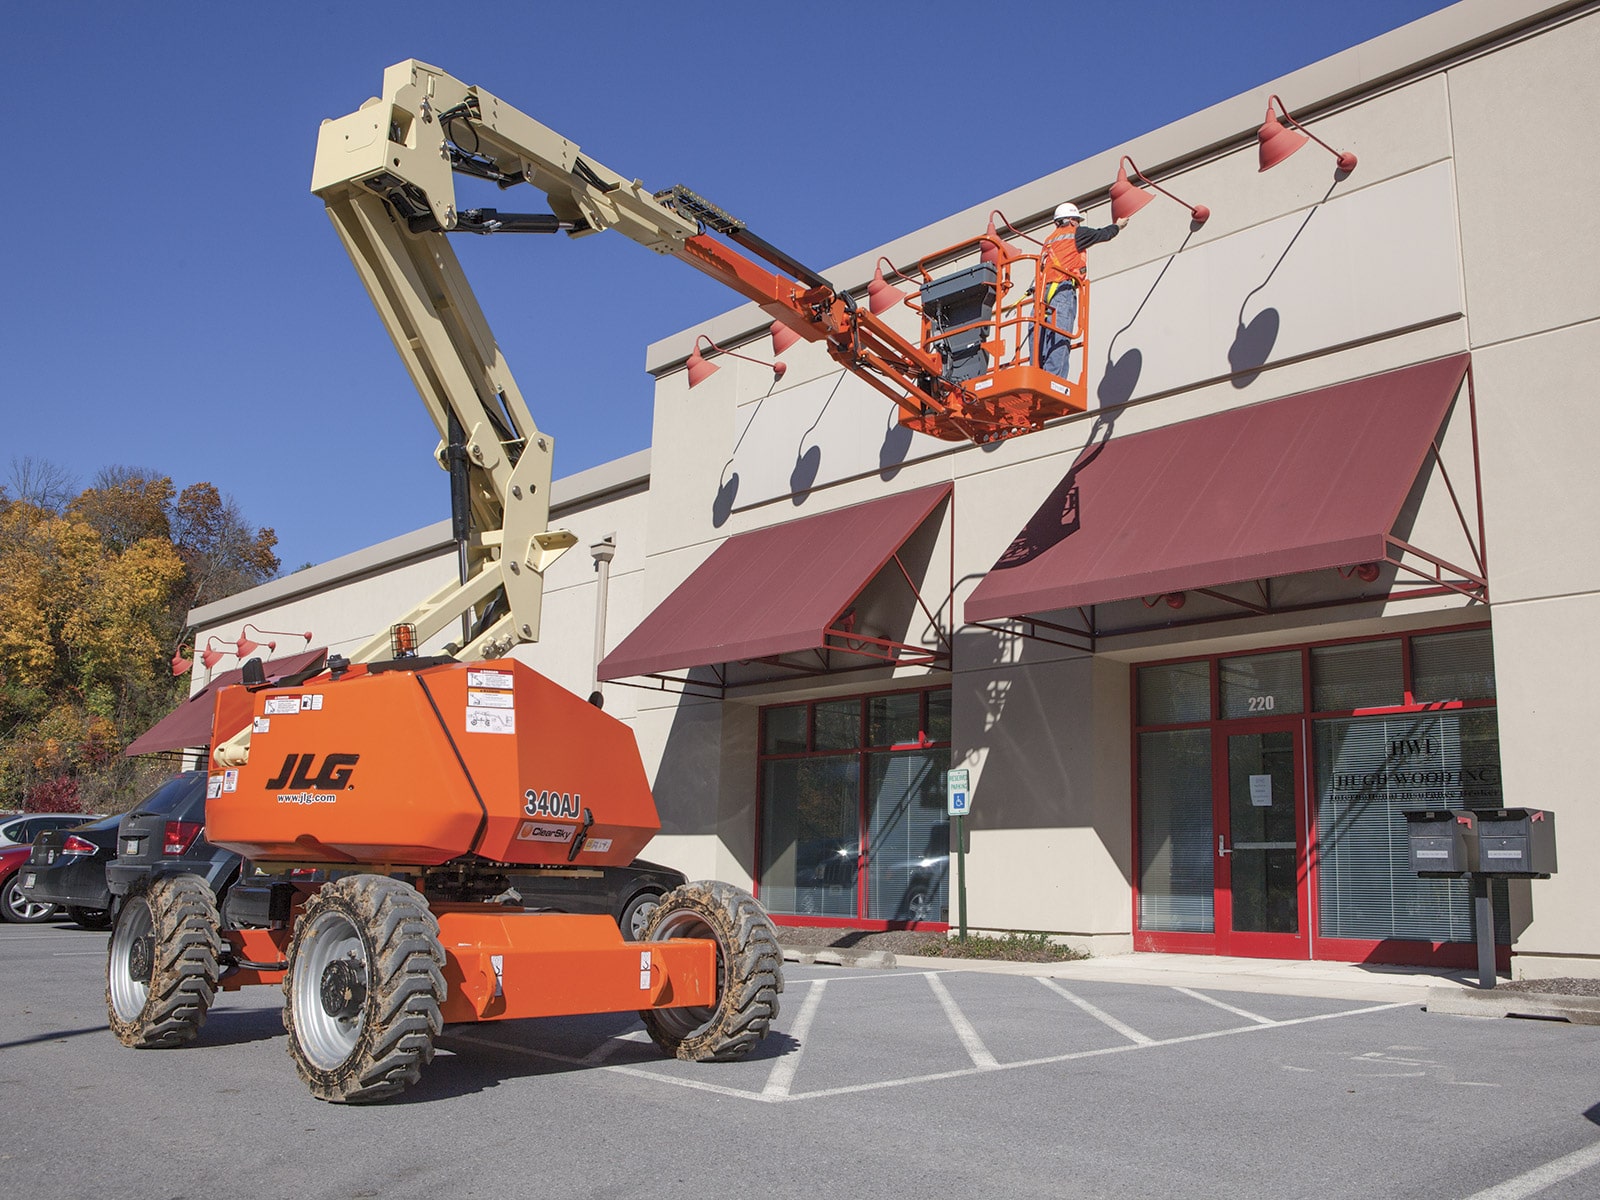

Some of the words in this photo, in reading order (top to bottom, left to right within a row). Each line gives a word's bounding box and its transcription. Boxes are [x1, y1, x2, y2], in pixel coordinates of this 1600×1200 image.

[1248, 696, 1274, 711] 220
[265, 753, 360, 790] JLG
[1392, 771, 1451, 785] WOOD
[277, 792, 336, 804] www.jlg.com
[524, 789, 580, 819] 340AJ
[532, 827, 572, 841] ClearSky
